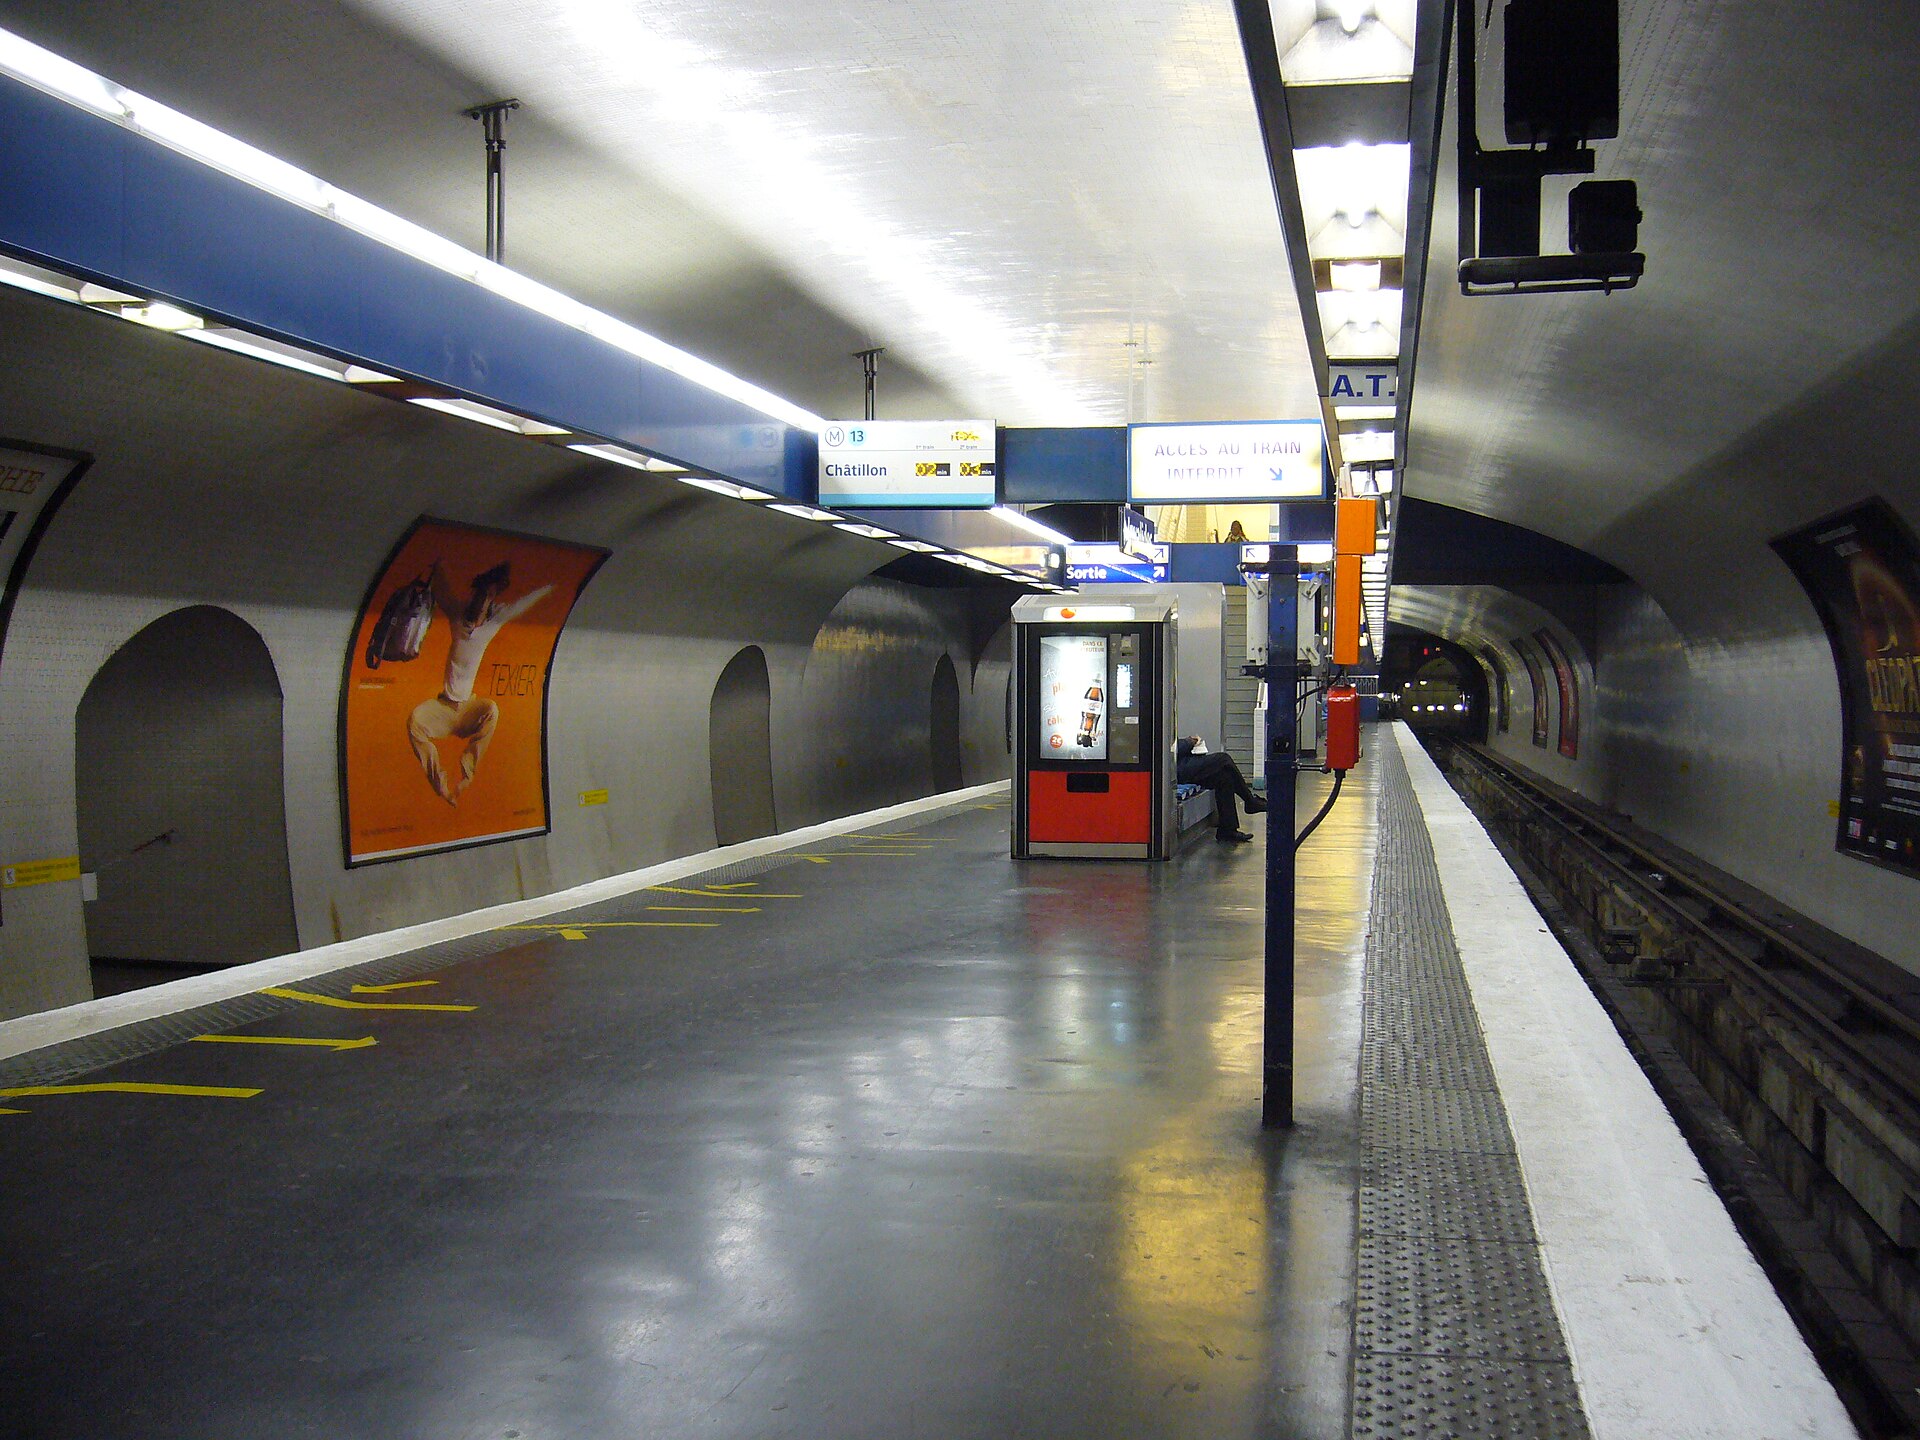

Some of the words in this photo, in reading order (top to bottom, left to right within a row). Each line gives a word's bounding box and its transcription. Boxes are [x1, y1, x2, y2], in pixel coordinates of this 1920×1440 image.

[1331, 374, 1395, 397] A.T.
[850, 430, 864, 442] 13
[1218, 442, 1240, 455] AU
[1253, 441, 1301, 454] TRAIN
[825, 463, 887, 477] Châtillon
[1167, 466, 1244, 480] INTERDIT
[1066, 564, 1107, 580] Sortie
[489, 663, 537, 697] TEXIER
